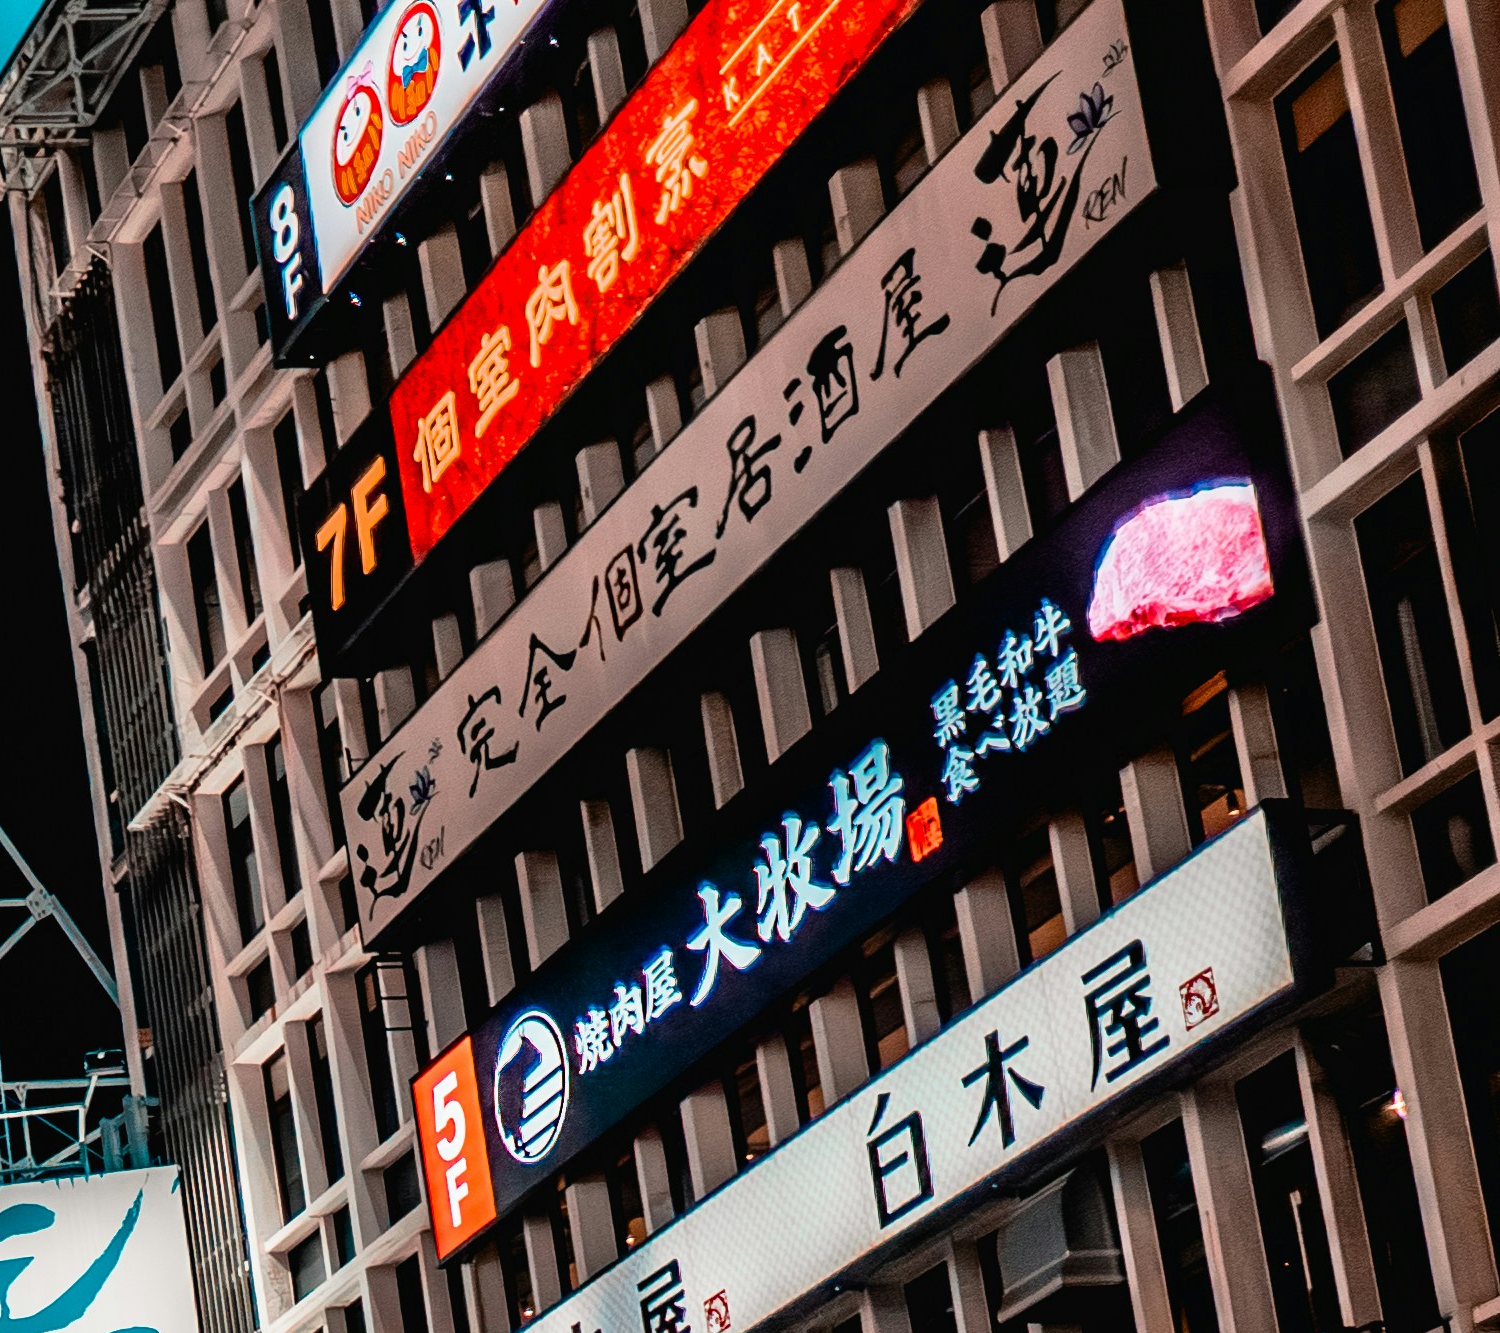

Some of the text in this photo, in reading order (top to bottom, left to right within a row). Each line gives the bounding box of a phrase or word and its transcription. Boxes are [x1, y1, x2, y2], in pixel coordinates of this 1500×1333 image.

[315, 454, 388, 612] 7F
[456, 246, 952, 799] 完全個室居酒屋
[929, 596, 1071, 747] 黒毛和牛
[940, 652, 1088, 804] 食べ放題
[574, 738, 908, 1077] 焼肉屋 大牧場
[431, 1069, 472, 1233] 5F
[863, 937, 1174, 1232] 白木屋
